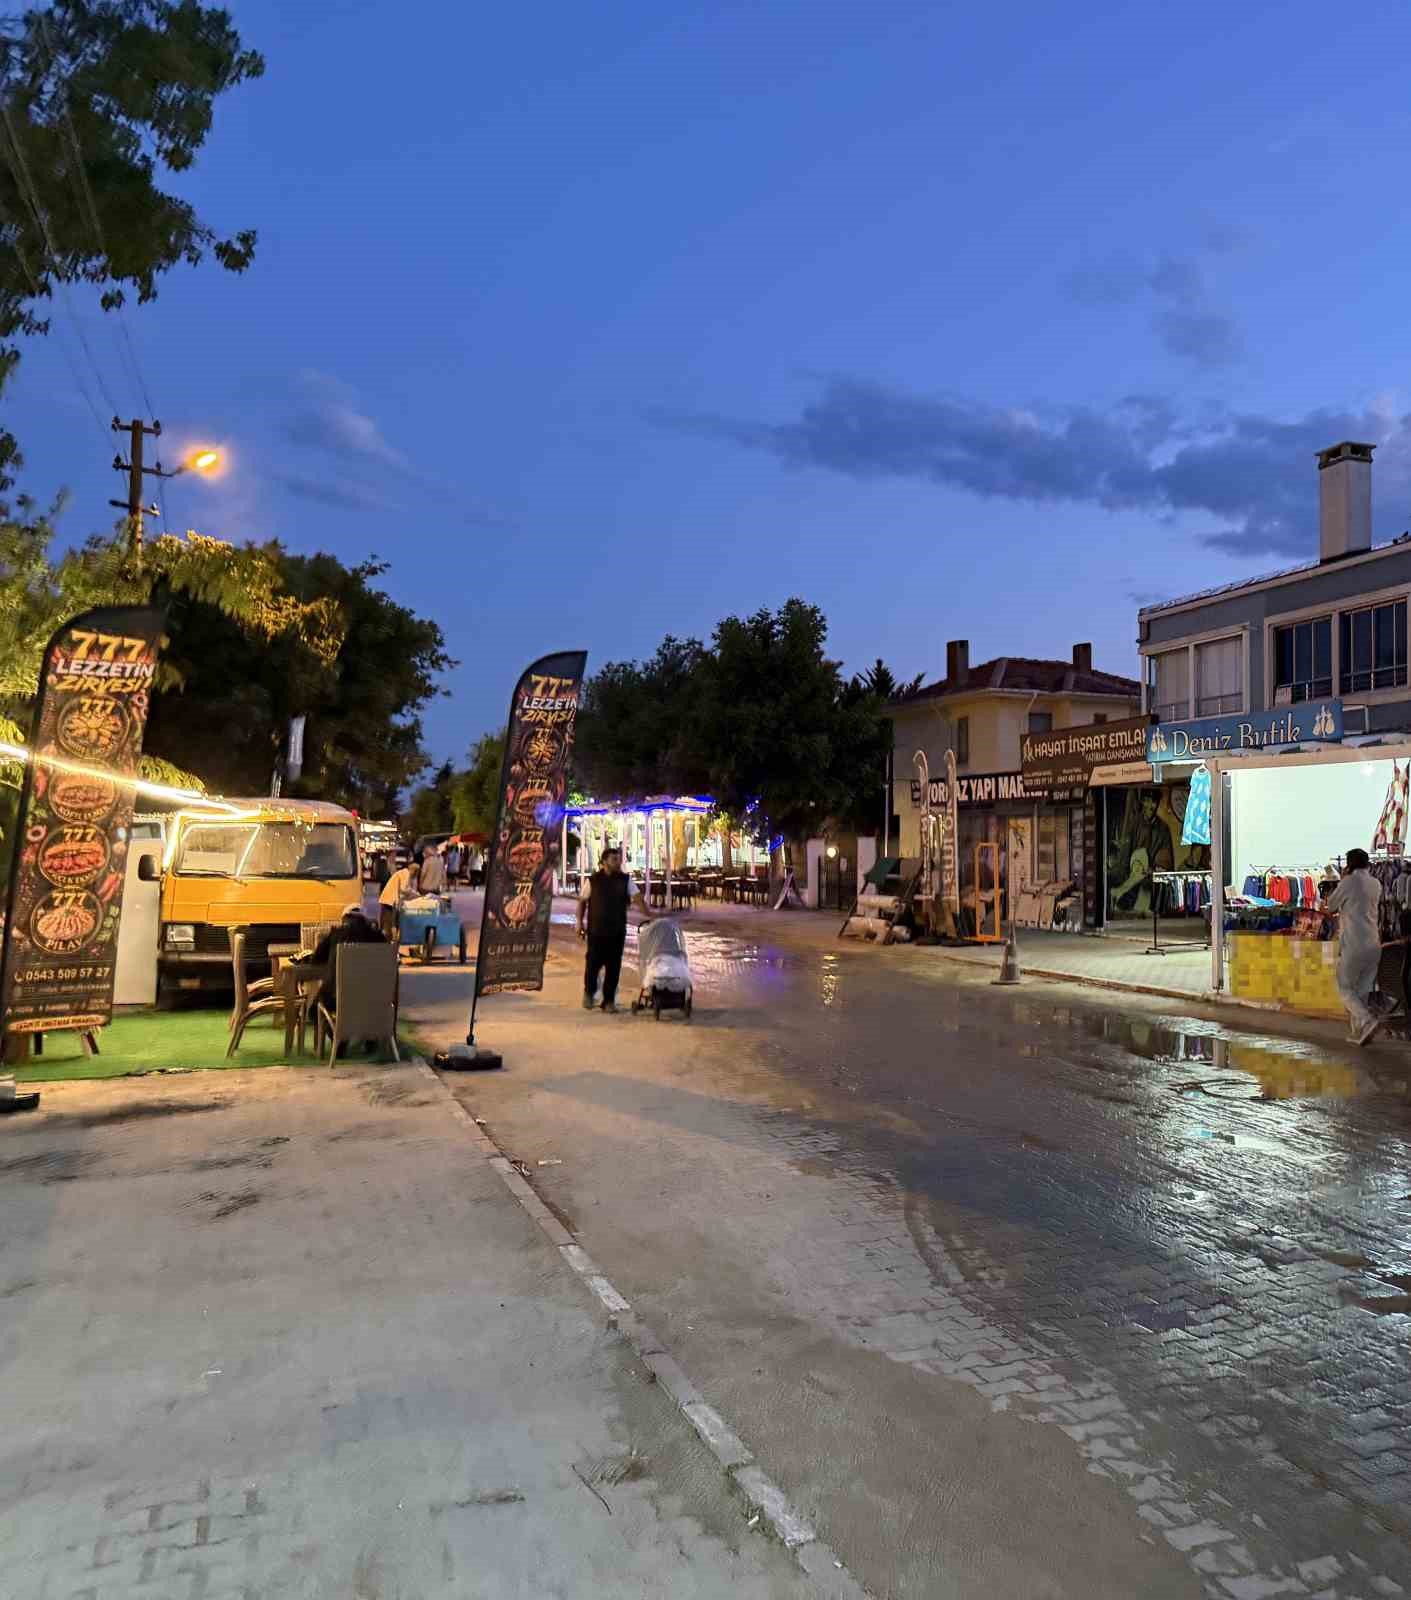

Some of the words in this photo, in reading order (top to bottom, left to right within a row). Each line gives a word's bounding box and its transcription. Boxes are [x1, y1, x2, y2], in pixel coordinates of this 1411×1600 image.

[72, 630, 146, 661] 777
[80, 698, 117, 713] 777
[1172, 728, 1232, 756] Deniz
[1238, 712, 1301, 747] Butik
[1034, 741, 1066, 758] HAYAT
[970, 776, 996, 801] YAPI
[63, 828, 97, 841] 777
[51, 892, 88, 909] 777
